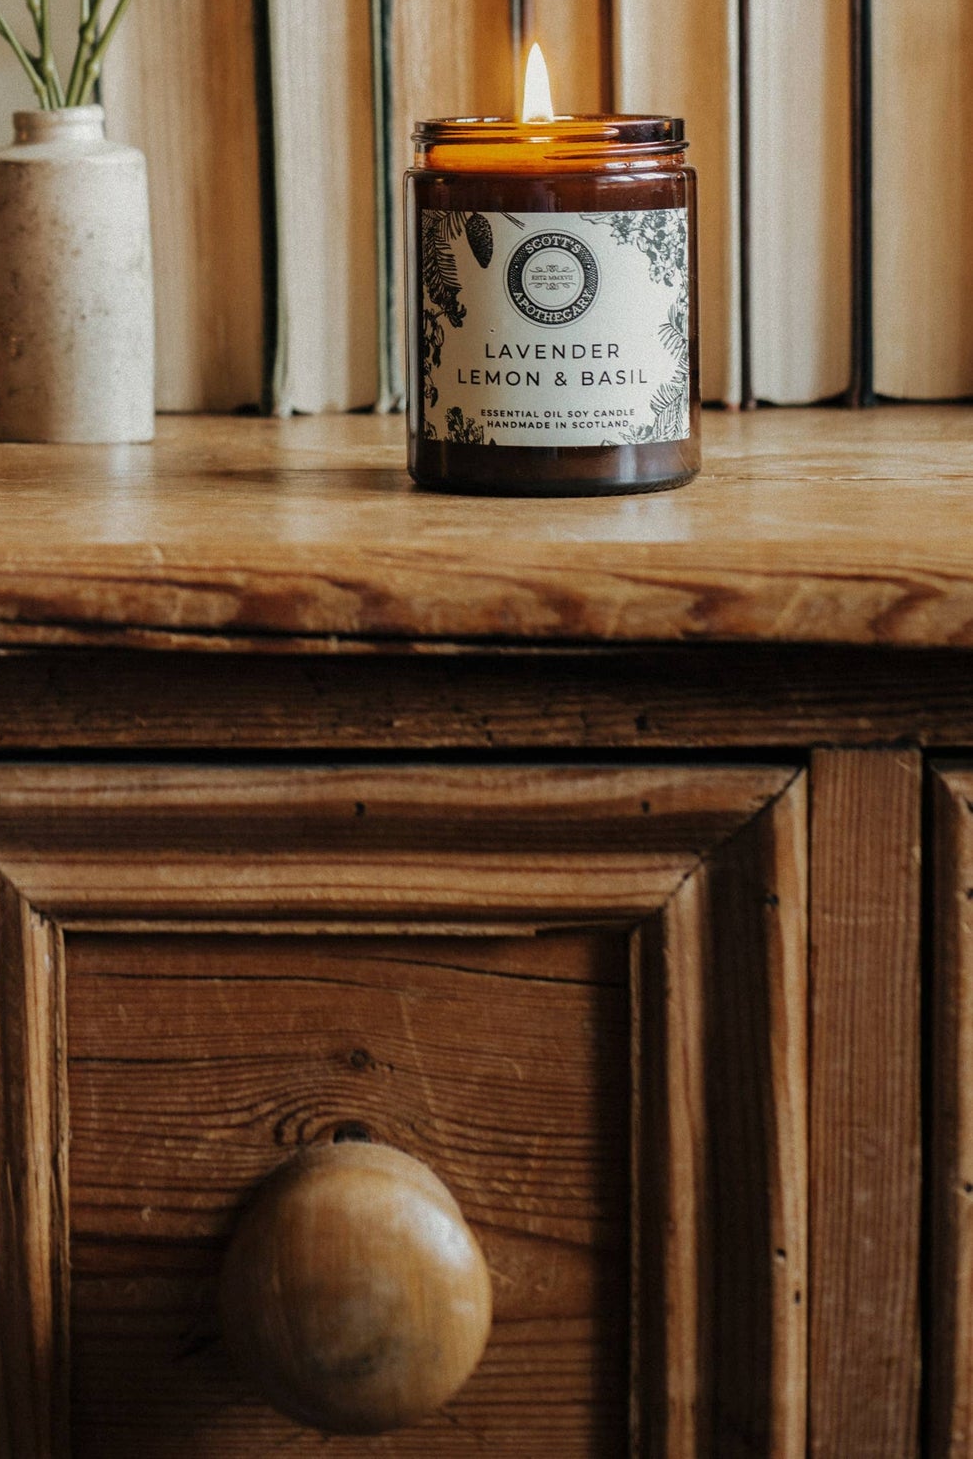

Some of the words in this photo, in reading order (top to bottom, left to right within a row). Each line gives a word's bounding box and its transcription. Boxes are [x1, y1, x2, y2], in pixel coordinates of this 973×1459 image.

[525, 236, 581, 254] SCOTT'S
[513, 290, 593, 321] APOTHECARY
[485, 343, 619, 360] LAVENDER
[458, 369, 540, 386] LEMON
[555, 370, 568, 386] &
[582, 370, 648, 386] BASIL
[481, 409, 539, 418] ESSENTIAL
[544, 409, 562, 418] OIL
[567, 409, 589, 418] SOY
[594, 409, 635, 417] CANDLE
[487, 420, 550, 429] HANDMADE
[556, 420, 567, 429] IN
[572, 420, 629, 429] SCOTLAND
